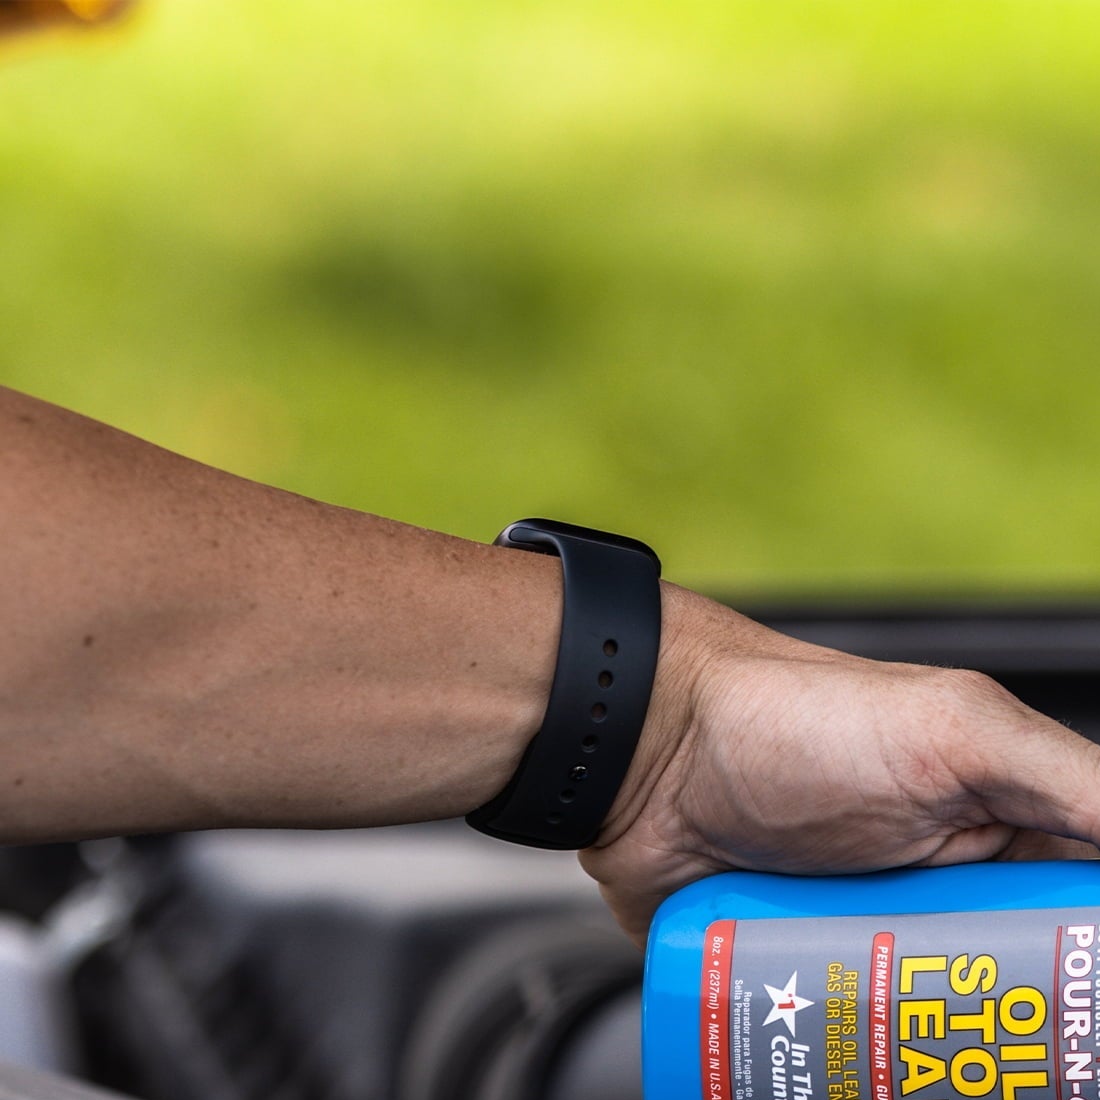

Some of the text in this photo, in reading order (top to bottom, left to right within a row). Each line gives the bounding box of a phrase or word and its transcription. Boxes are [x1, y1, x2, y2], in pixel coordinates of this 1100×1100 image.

[711, 935, 724, 957] 8oz.
[706, 969, 721, 1011] (237ml)
[733, 979, 744, 1000] Sella
[826, 961, 844, 993] GAS
[874, 945, 889, 1021] PERMANENT
[742, 991, 753, 1034] Reparador
[825, 997, 842, 1019] OR
[841, 970, 859, 1036] REPAIRS
[708, 1022, 720, 1056] MADE
[733, 1002, 743, 1080] Permanentemente
[741, 1037, 752, 1057] para
[825, 1023, 842, 1079] DIESEL
[841, 1039, 858, 1066] OIL
[873, 1023, 888, 1069] REPAIR
[709, 1057, 720, 1070] IN
[791, 1042, 811, 1067] In
[742, 1059, 753, 1085] Fugas
[745, 1087, 755, 1098] de
